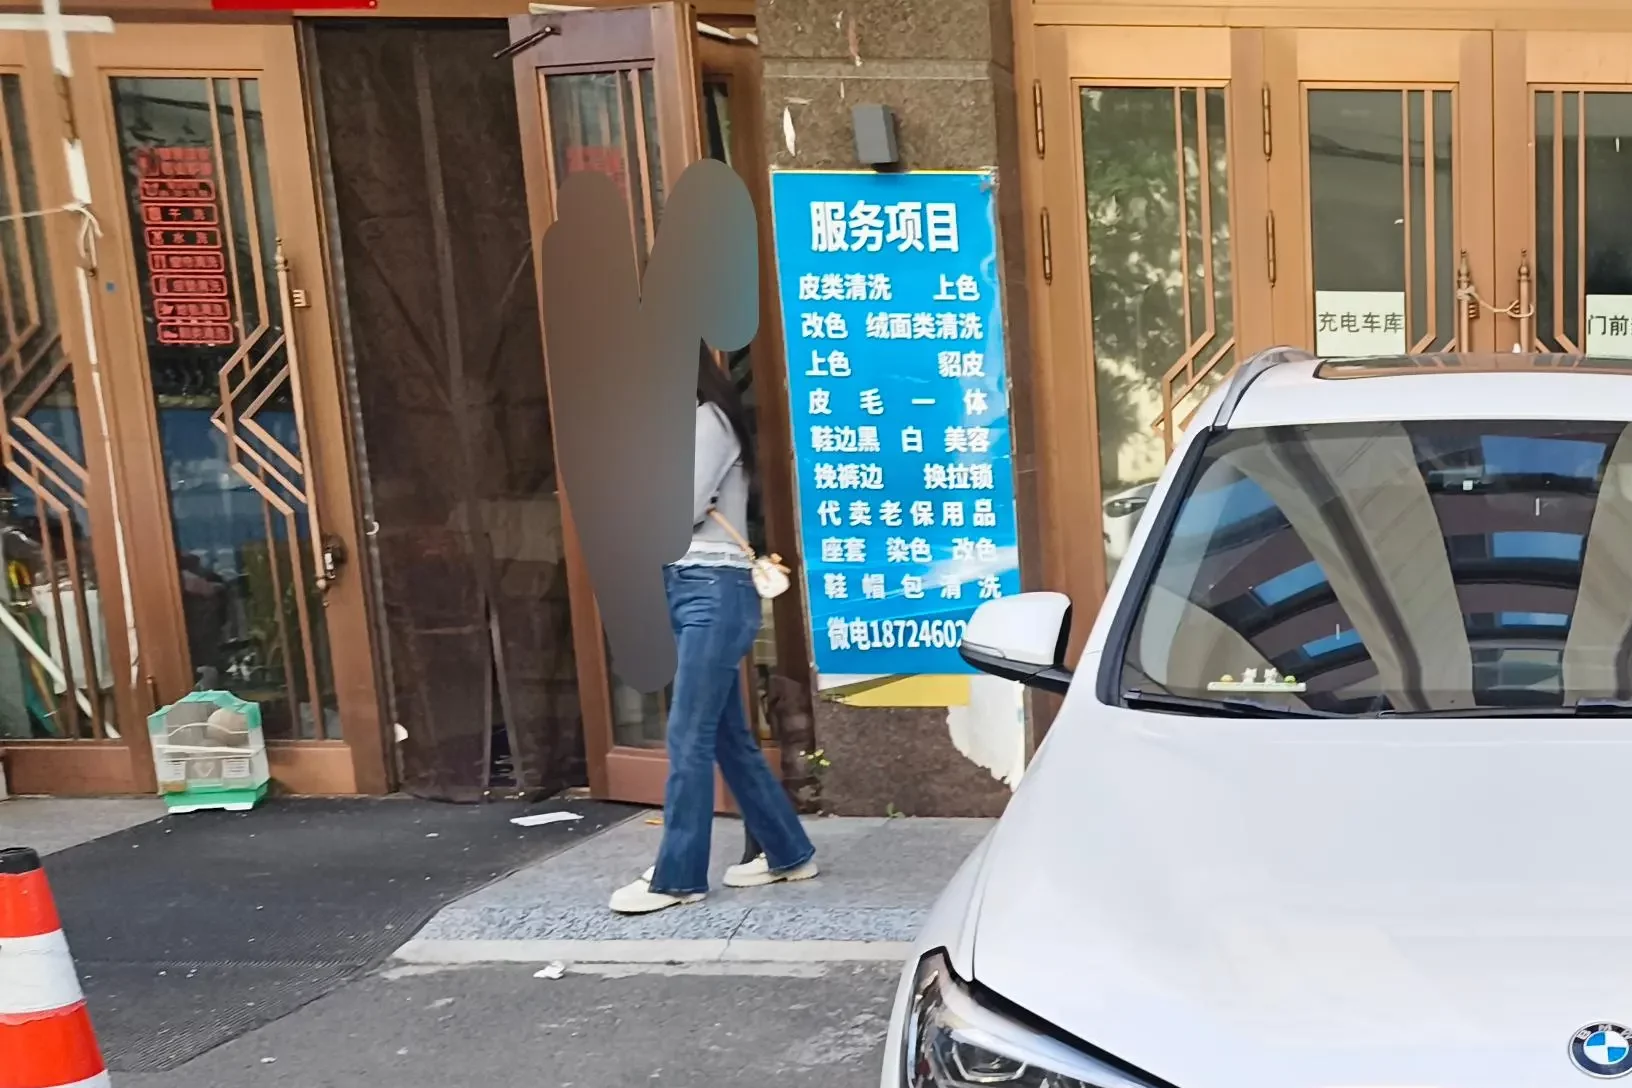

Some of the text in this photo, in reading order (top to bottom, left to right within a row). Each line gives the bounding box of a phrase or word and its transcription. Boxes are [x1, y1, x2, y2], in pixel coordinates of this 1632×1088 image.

[810, 200, 960, 252] 服务项目
[799, 273, 980, 301] 皮类清洗 上色
[801, 312, 983, 340] 改色 绒面类清洗
[1318, 312, 1404, 334] 充电车库
[805, 350, 985, 378] 上色 貂皮
[808, 388, 989, 416] 皮毛一体
[810, 425, 990, 453] 鞋边黑 白 美容
[814, 463, 994, 490] 挽裤边 换拉锁
[817, 498, 996, 527] 代卖老保用品
[821, 536, 998, 563] 座套 染色 改色
[823, 572, 1002, 599] 鞋帽包清洗
